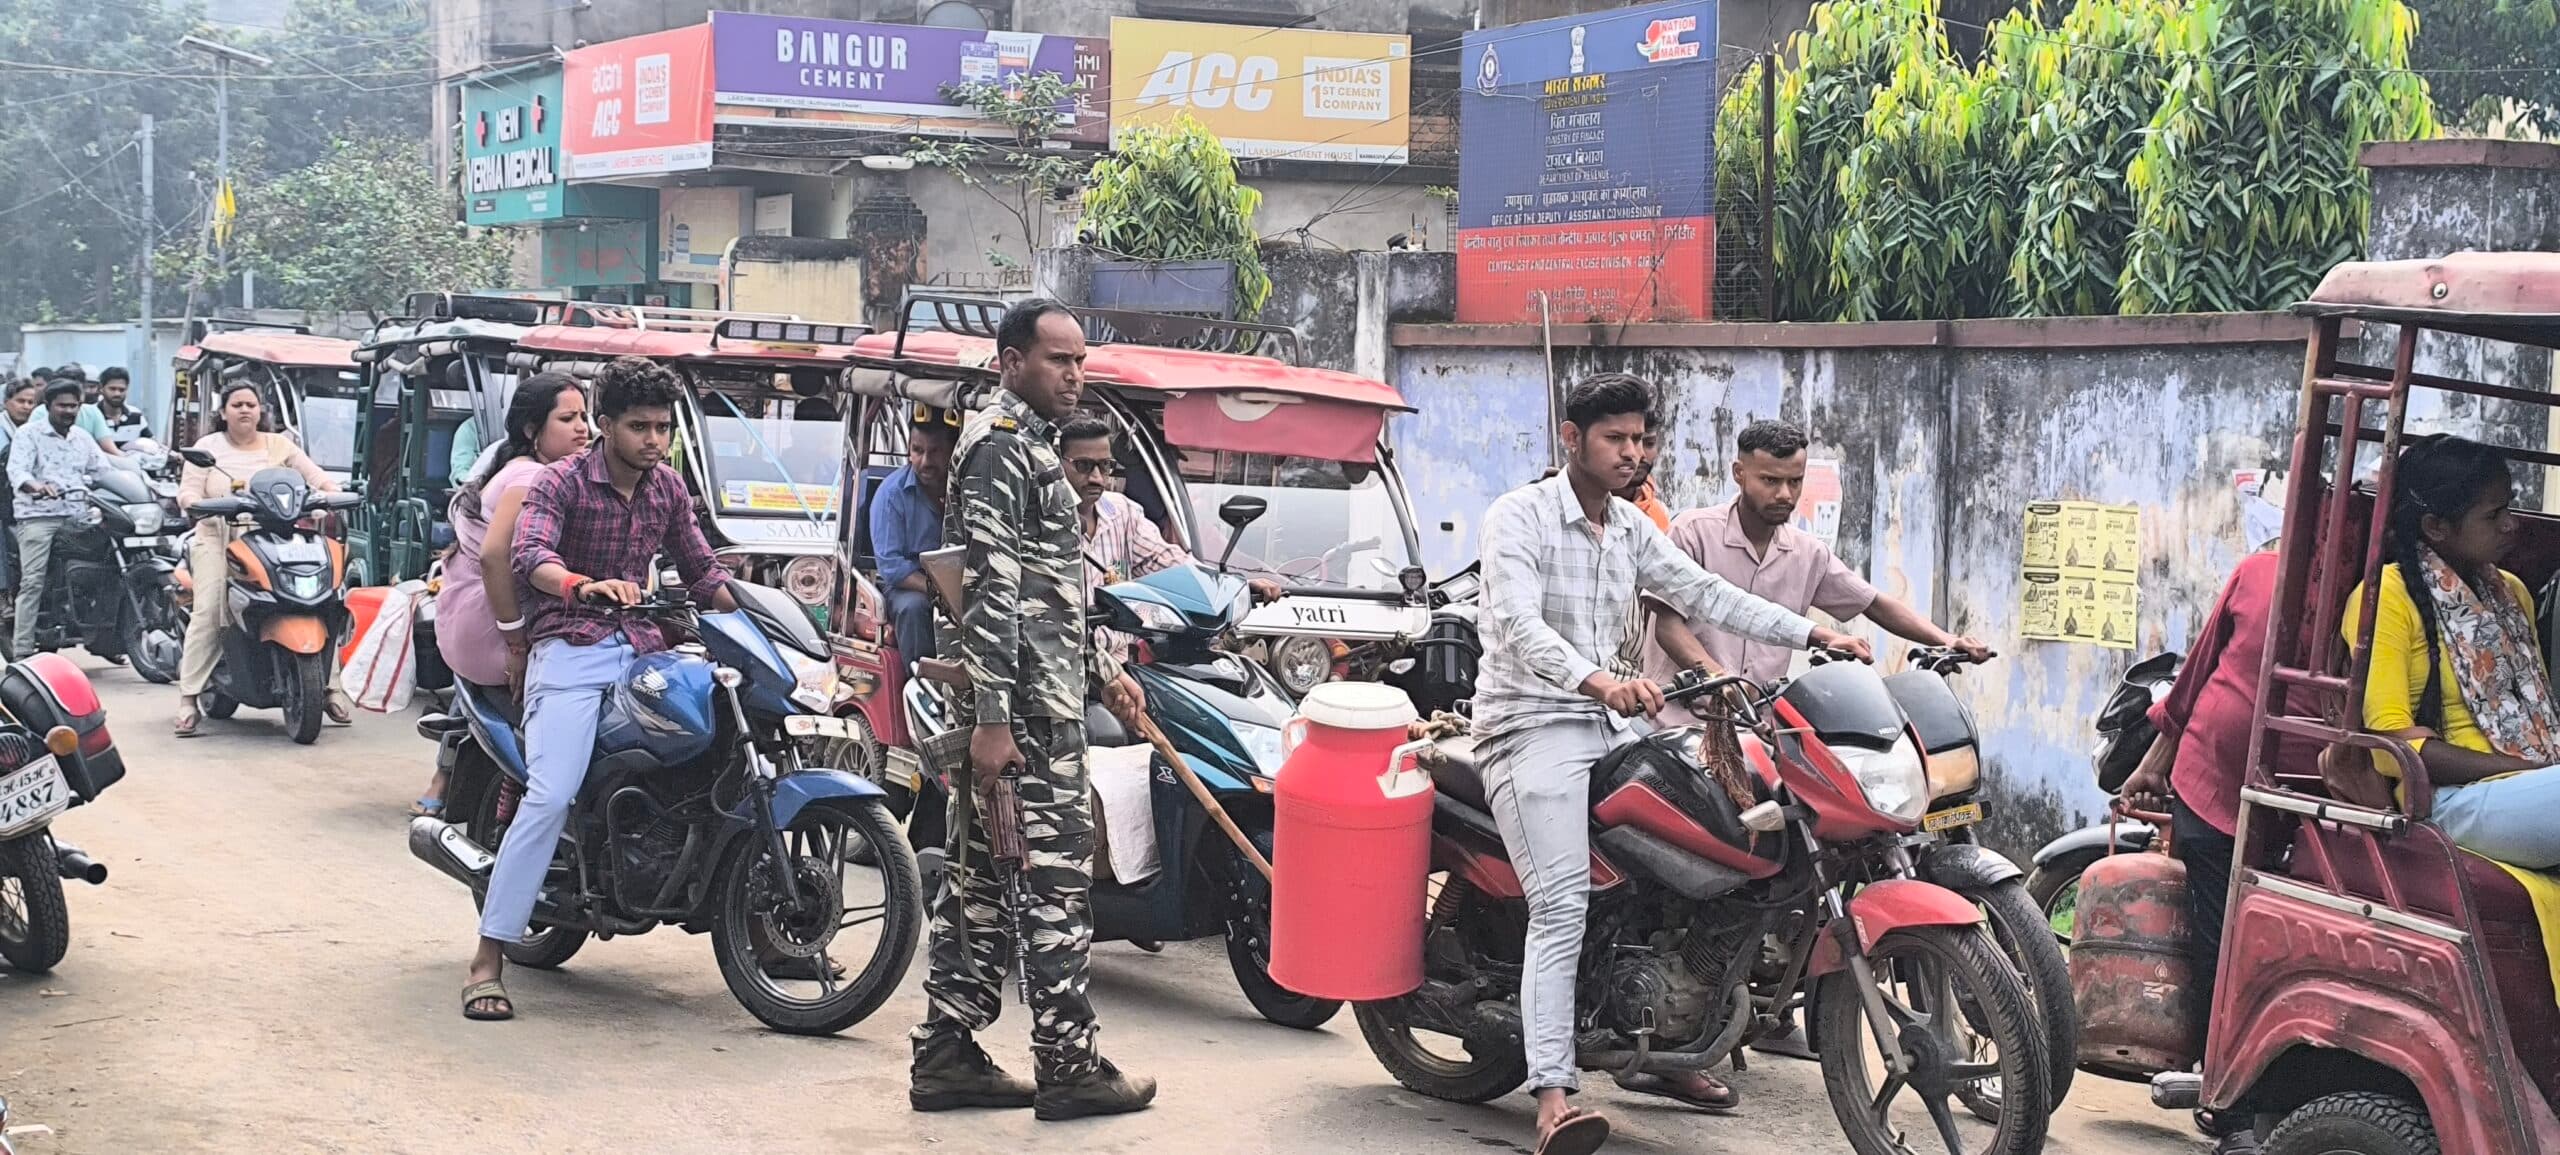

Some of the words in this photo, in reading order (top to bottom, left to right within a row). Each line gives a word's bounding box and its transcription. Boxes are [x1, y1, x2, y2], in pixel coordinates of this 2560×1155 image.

[1662, 17, 1695, 31] NATION
[777, 28, 907, 70] BANGUR
[1660, 43, 1699, 57] MARKET
[1661, 35, 1678, 45] TAX
[592, 53, 622, 94] adani
[800, 68, 885, 91] CEMENT
[1135, 51, 1278, 111] ACC
[1315, 66, 1381, 85] INDIA'S
[1337, 88, 1380, 98] CEMENT
[1544, 77, 1568, 94] भारत
[1323, 99, 1381, 112] COMPANY
[496, 106, 521, 143] NEW
[592, 99, 622, 137] ACC
[1289, 150, 1321, 159] CEMENT
[1324, 150, 1352, 161] HOUSE
[468, 154, 503, 193] VERMA
[504, 147, 555, 188] MEDICAL
[1491, 214, 1512, 226] OFFICE
[1513, 214, 1522, 225] OF
[1523, 213, 1536, 223] THE
[1569, 208, 1606, 221] ASSISTANT
[1607, 205, 1662, 219] COMMISSIONER
[1291, 604, 1346, 625] yatri
[0, 781, 54, 823] 4887
